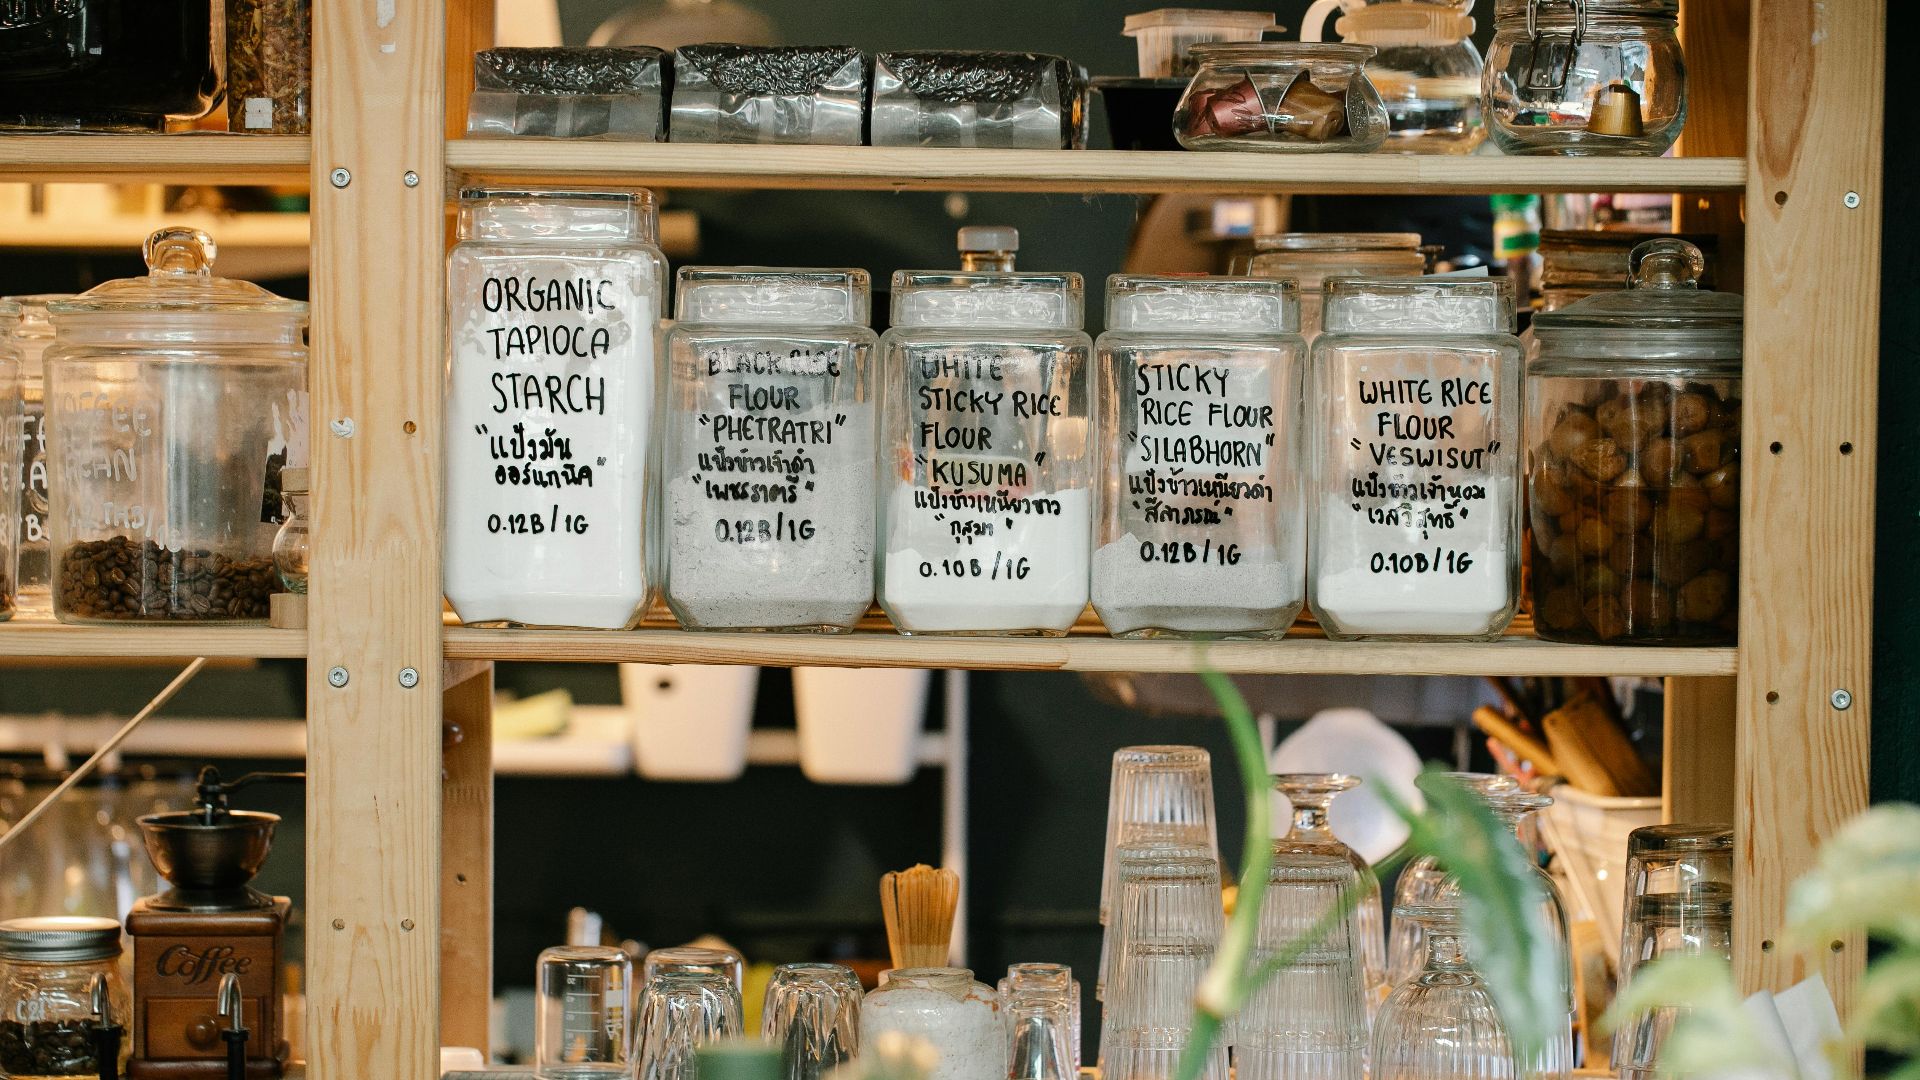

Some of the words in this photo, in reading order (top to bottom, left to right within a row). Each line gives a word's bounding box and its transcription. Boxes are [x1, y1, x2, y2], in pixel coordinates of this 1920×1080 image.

[483, 276, 615, 314] ORGANIC
[486, 324, 610, 360] TAPIOCA
[708, 348, 782, 377] BLACK
[921, 354, 1004, 382] WHITE
[491, 372, 606, 415] STARCH
[728, 383, 801, 411] FLOUR
[1136, 363, 1230, 398] STICKY
[1358, 378, 1433, 405] WHITE
[1441, 377, 1492, 407] RICE
[56, 391, 152, 437] OFFEE
[918, 385, 1004, 416] STICKY
[1011, 390, 1061, 420] RICE
[1140, 397, 1194, 427] RICE
[1208, 402, 1274, 429] FLOUR
[920, 421, 993, 451] FLOUR
[1377, 411, 1456, 440] FLOUR
[156, 943, 252, 986] Coffee
